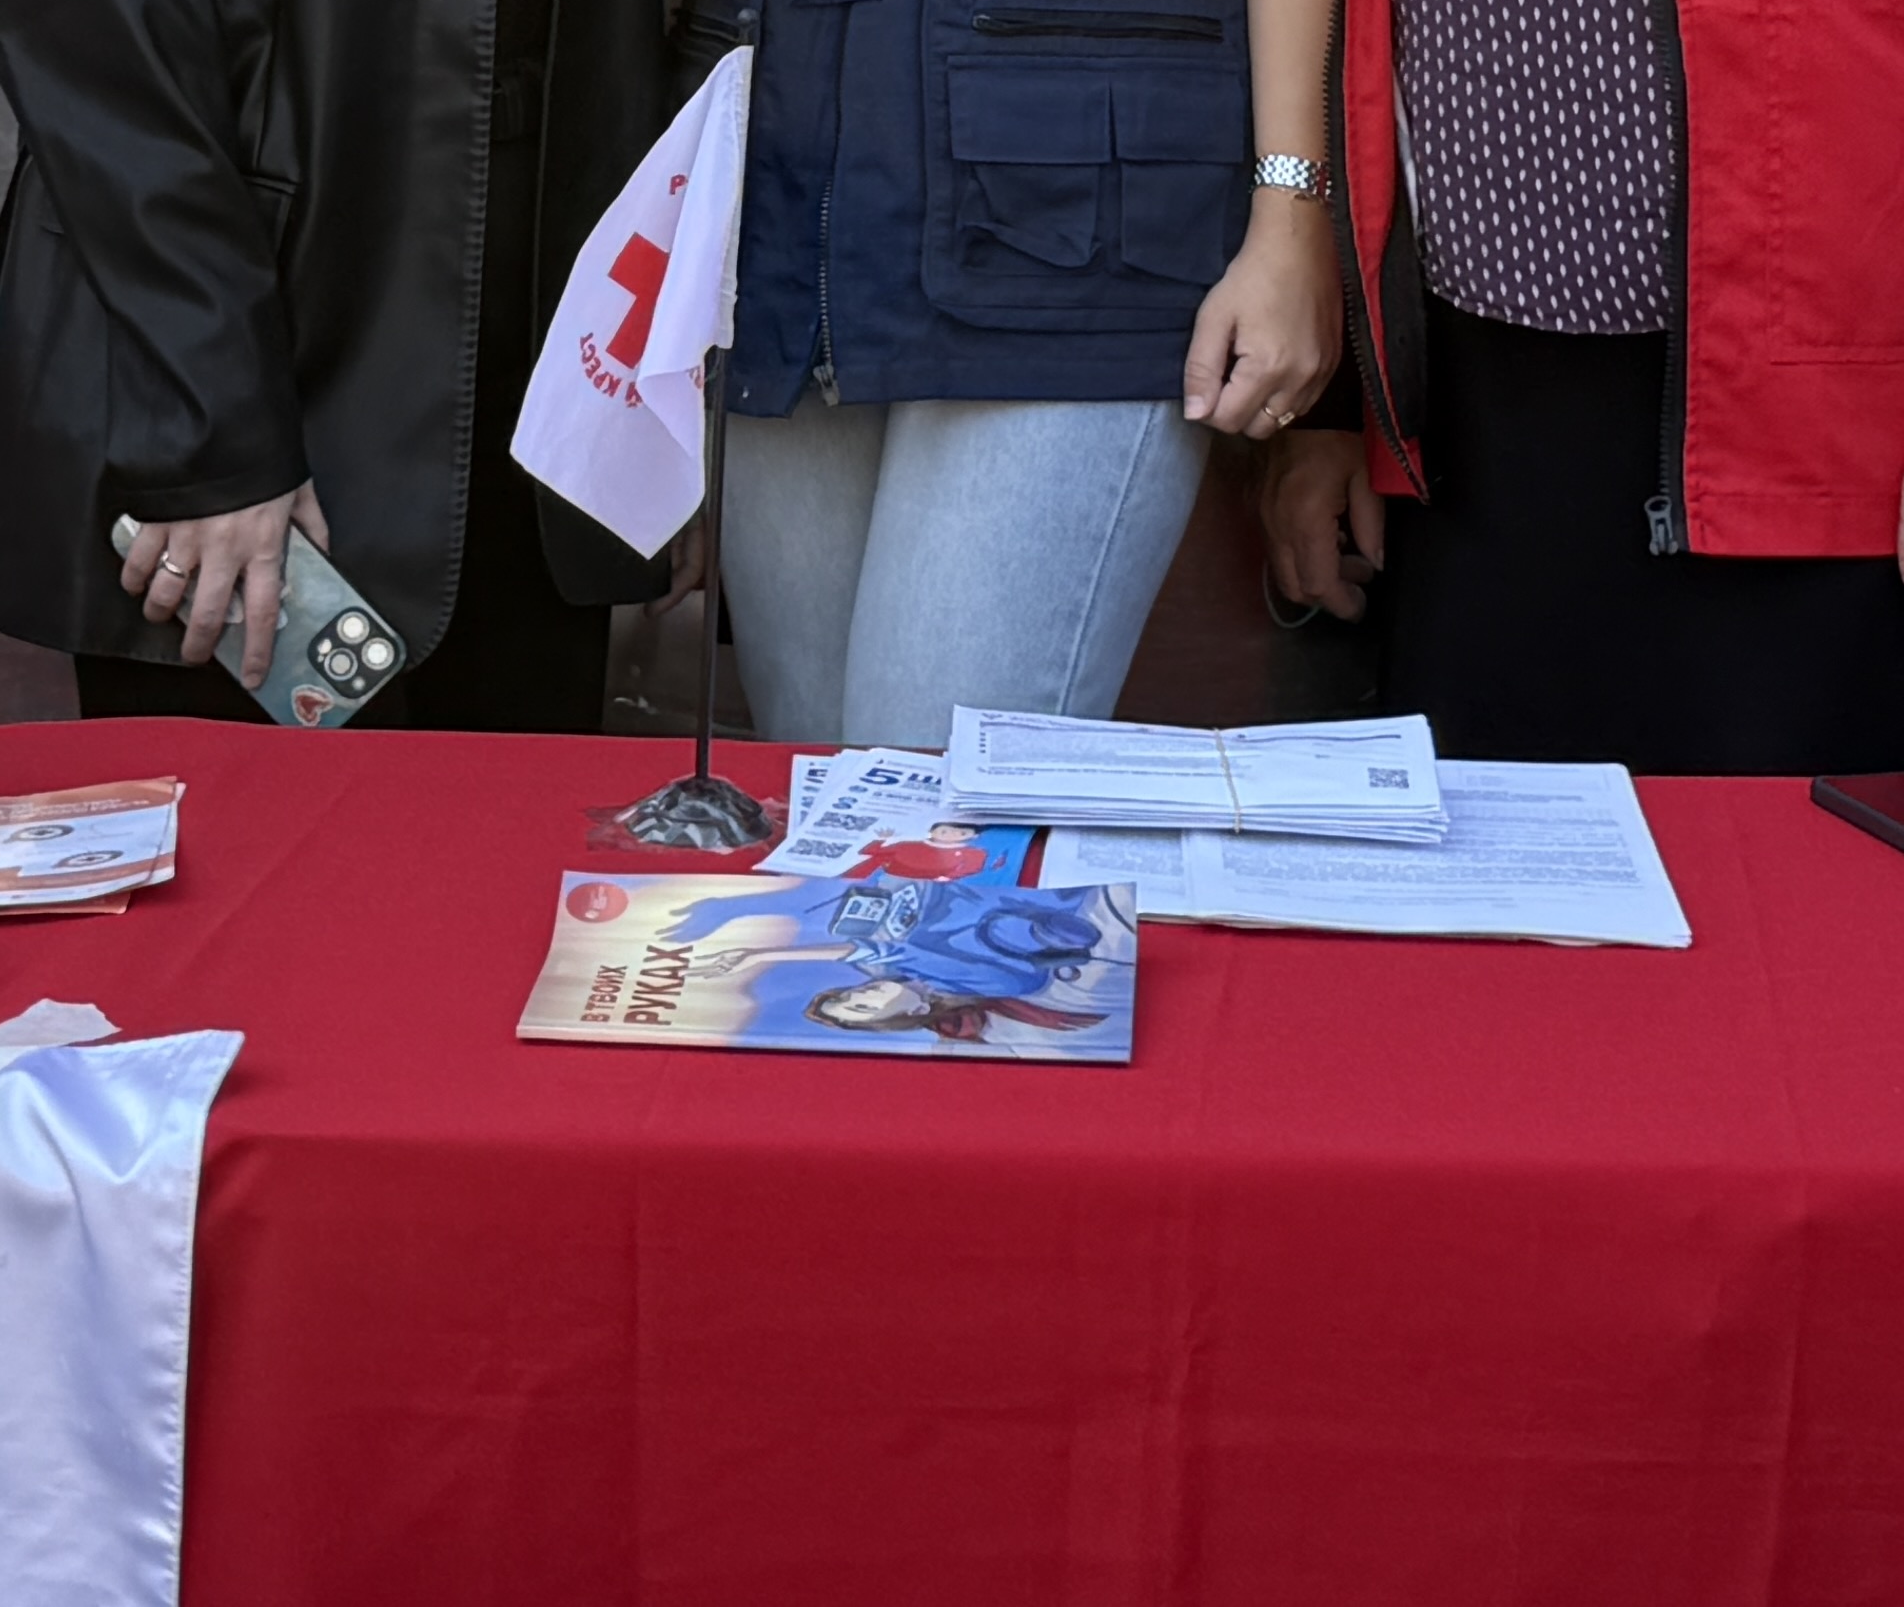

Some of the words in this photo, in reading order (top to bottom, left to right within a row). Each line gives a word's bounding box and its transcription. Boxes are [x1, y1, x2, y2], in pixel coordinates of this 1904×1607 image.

[859, 767, 904, 786] 5
[585, 964, 629, 1011] ТВОИХ
[623, 944, 694, 1026] РУКАХ
[580, 1012, 610, 1023] В
